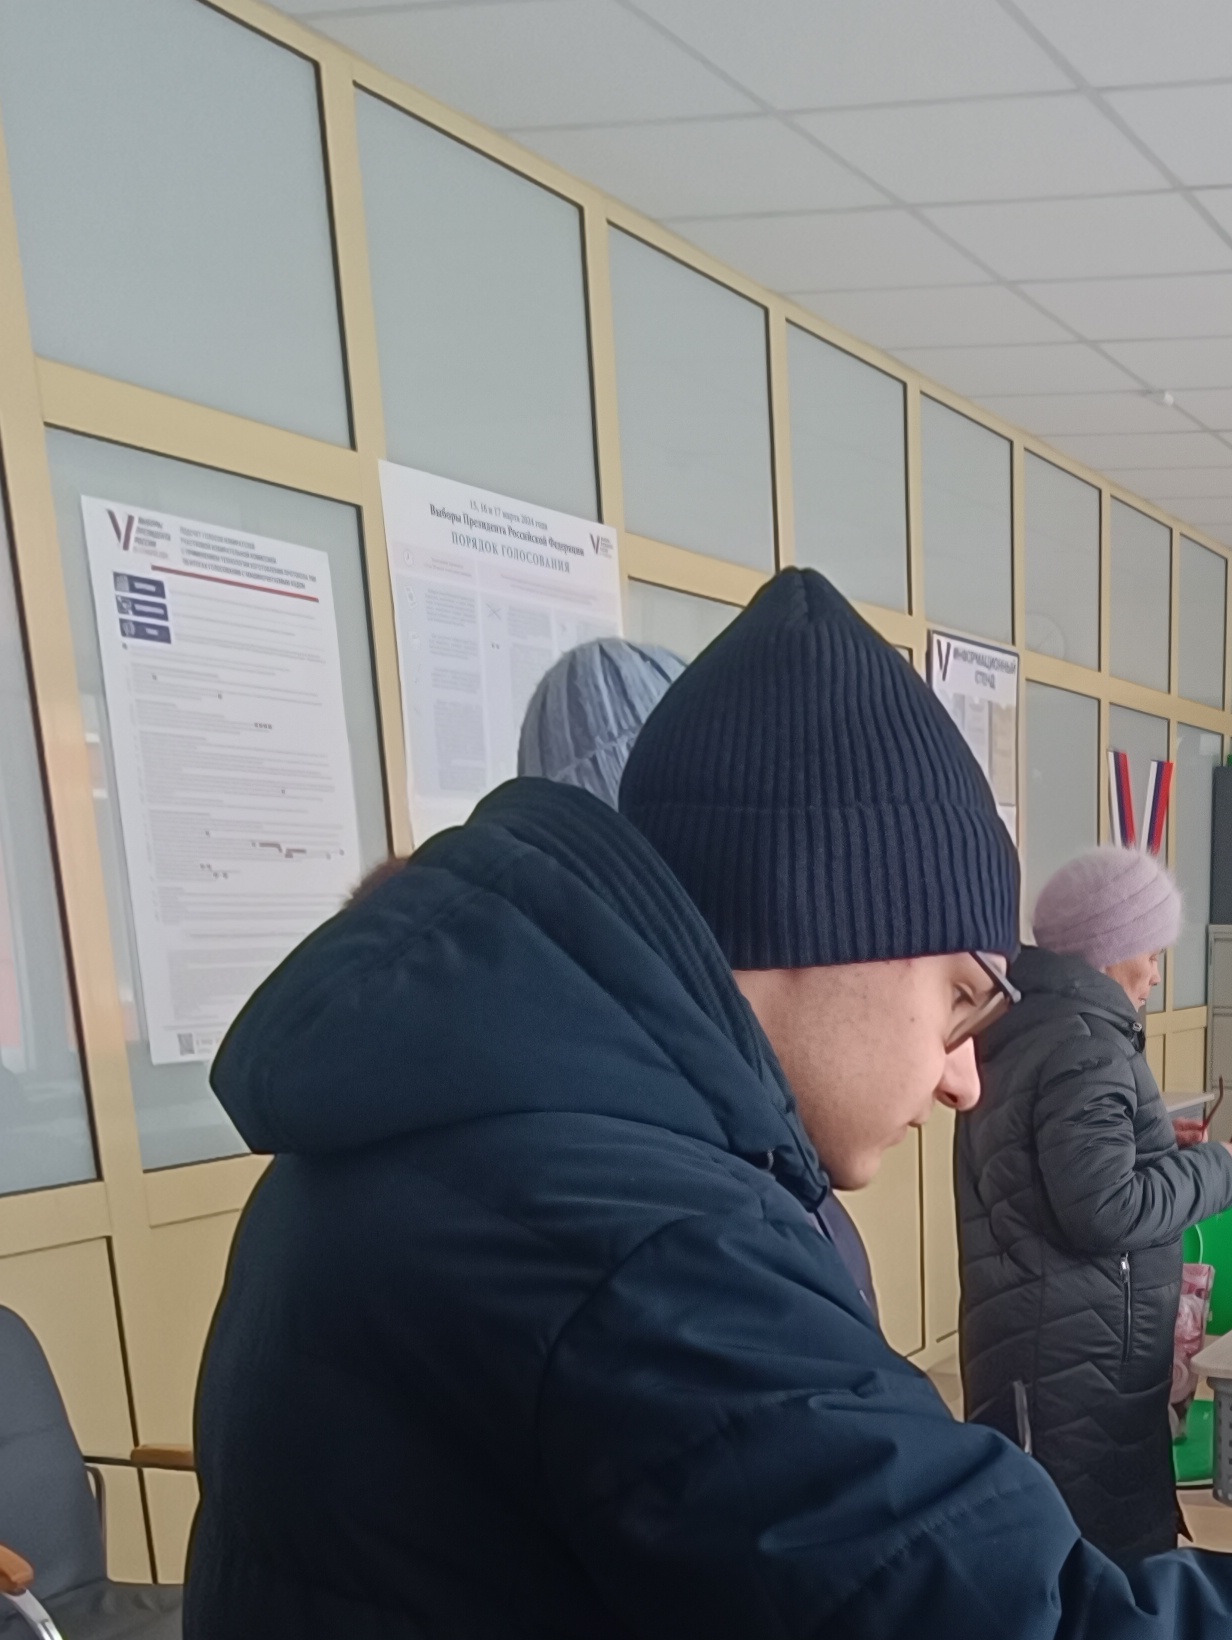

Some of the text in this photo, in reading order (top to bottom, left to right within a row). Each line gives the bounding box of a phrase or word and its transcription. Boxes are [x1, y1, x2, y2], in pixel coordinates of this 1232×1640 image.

[430, 503, 462, 524] Выборы
[463, 512, 507, 536] Президента
[507, 524, 548, 546] Российской
[548, 536, 585, 556] Федерации
[451, 531, 499, 556] ПОРЯДОК
[501, 544, 570, 573] ГОЛОСОВАНИЯ
